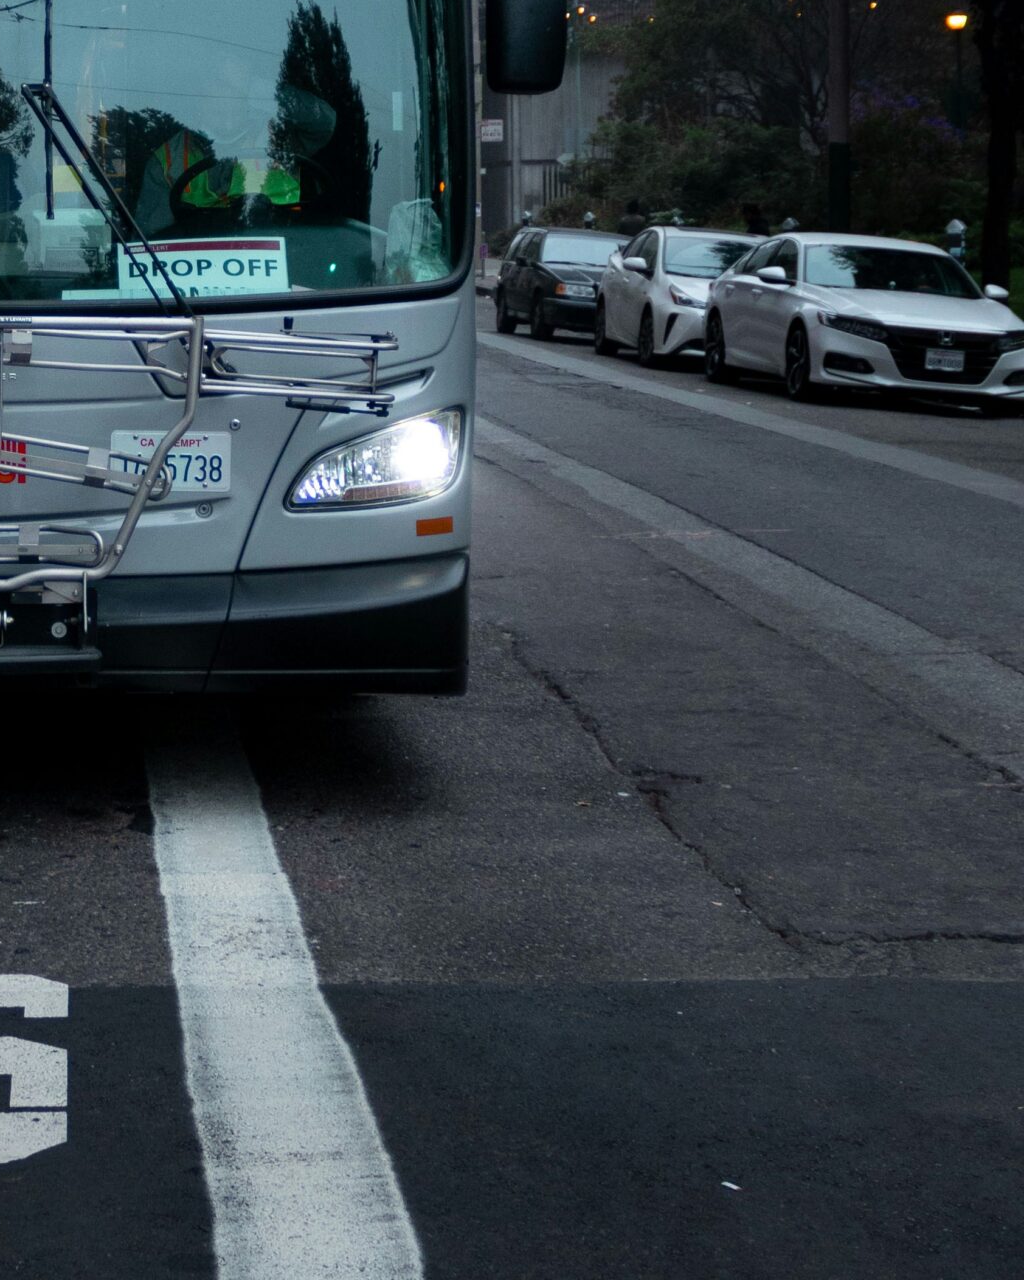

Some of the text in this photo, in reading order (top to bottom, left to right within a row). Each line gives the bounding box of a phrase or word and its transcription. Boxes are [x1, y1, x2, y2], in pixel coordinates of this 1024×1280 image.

[128, 258, 279, 278] DROP OFF
[140, 438, 155, 447] CA
